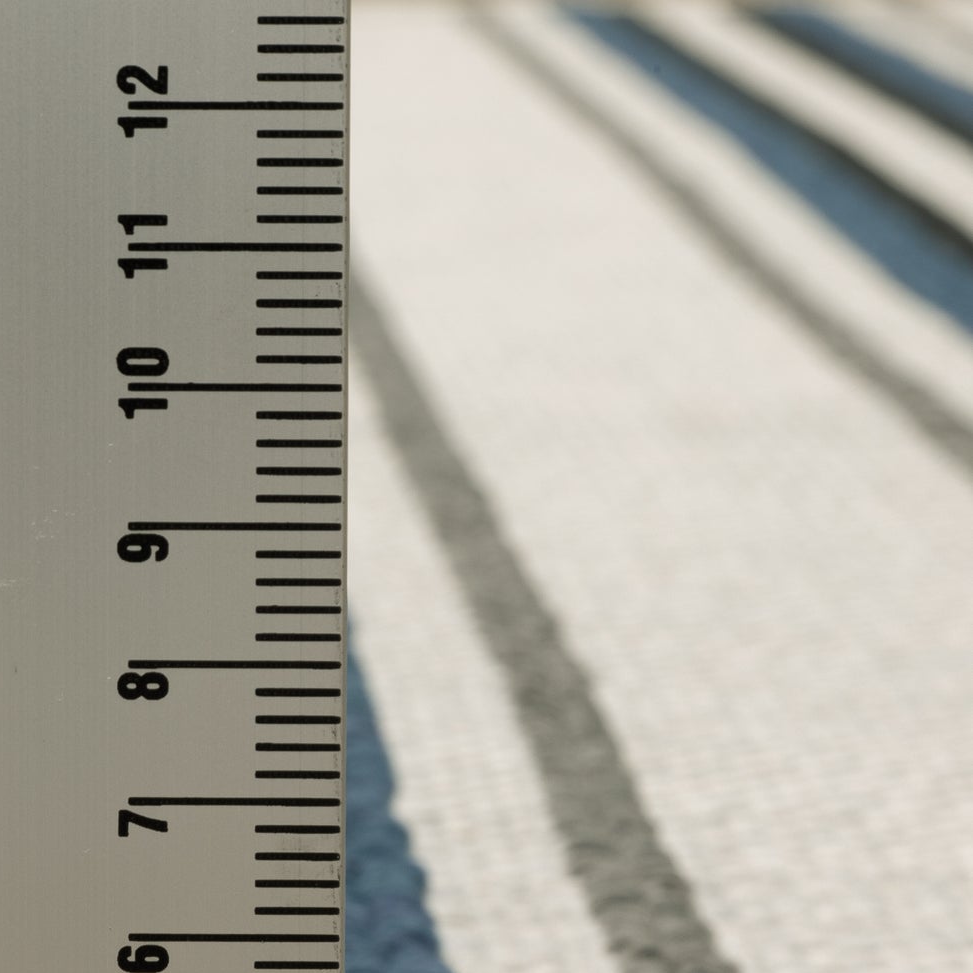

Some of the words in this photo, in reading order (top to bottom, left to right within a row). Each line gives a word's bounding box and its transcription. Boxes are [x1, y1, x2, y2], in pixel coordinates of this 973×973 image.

[116, 65, 168, 138] 12
[117, 215, 168, 279] 11
[116, 347, 169, 419] 10
[117, 533, 169, 562] 9
[117, 672, 169, 700] 8
[118, 810, 169, 837] 7
[117, 945, 169, 973] 6
